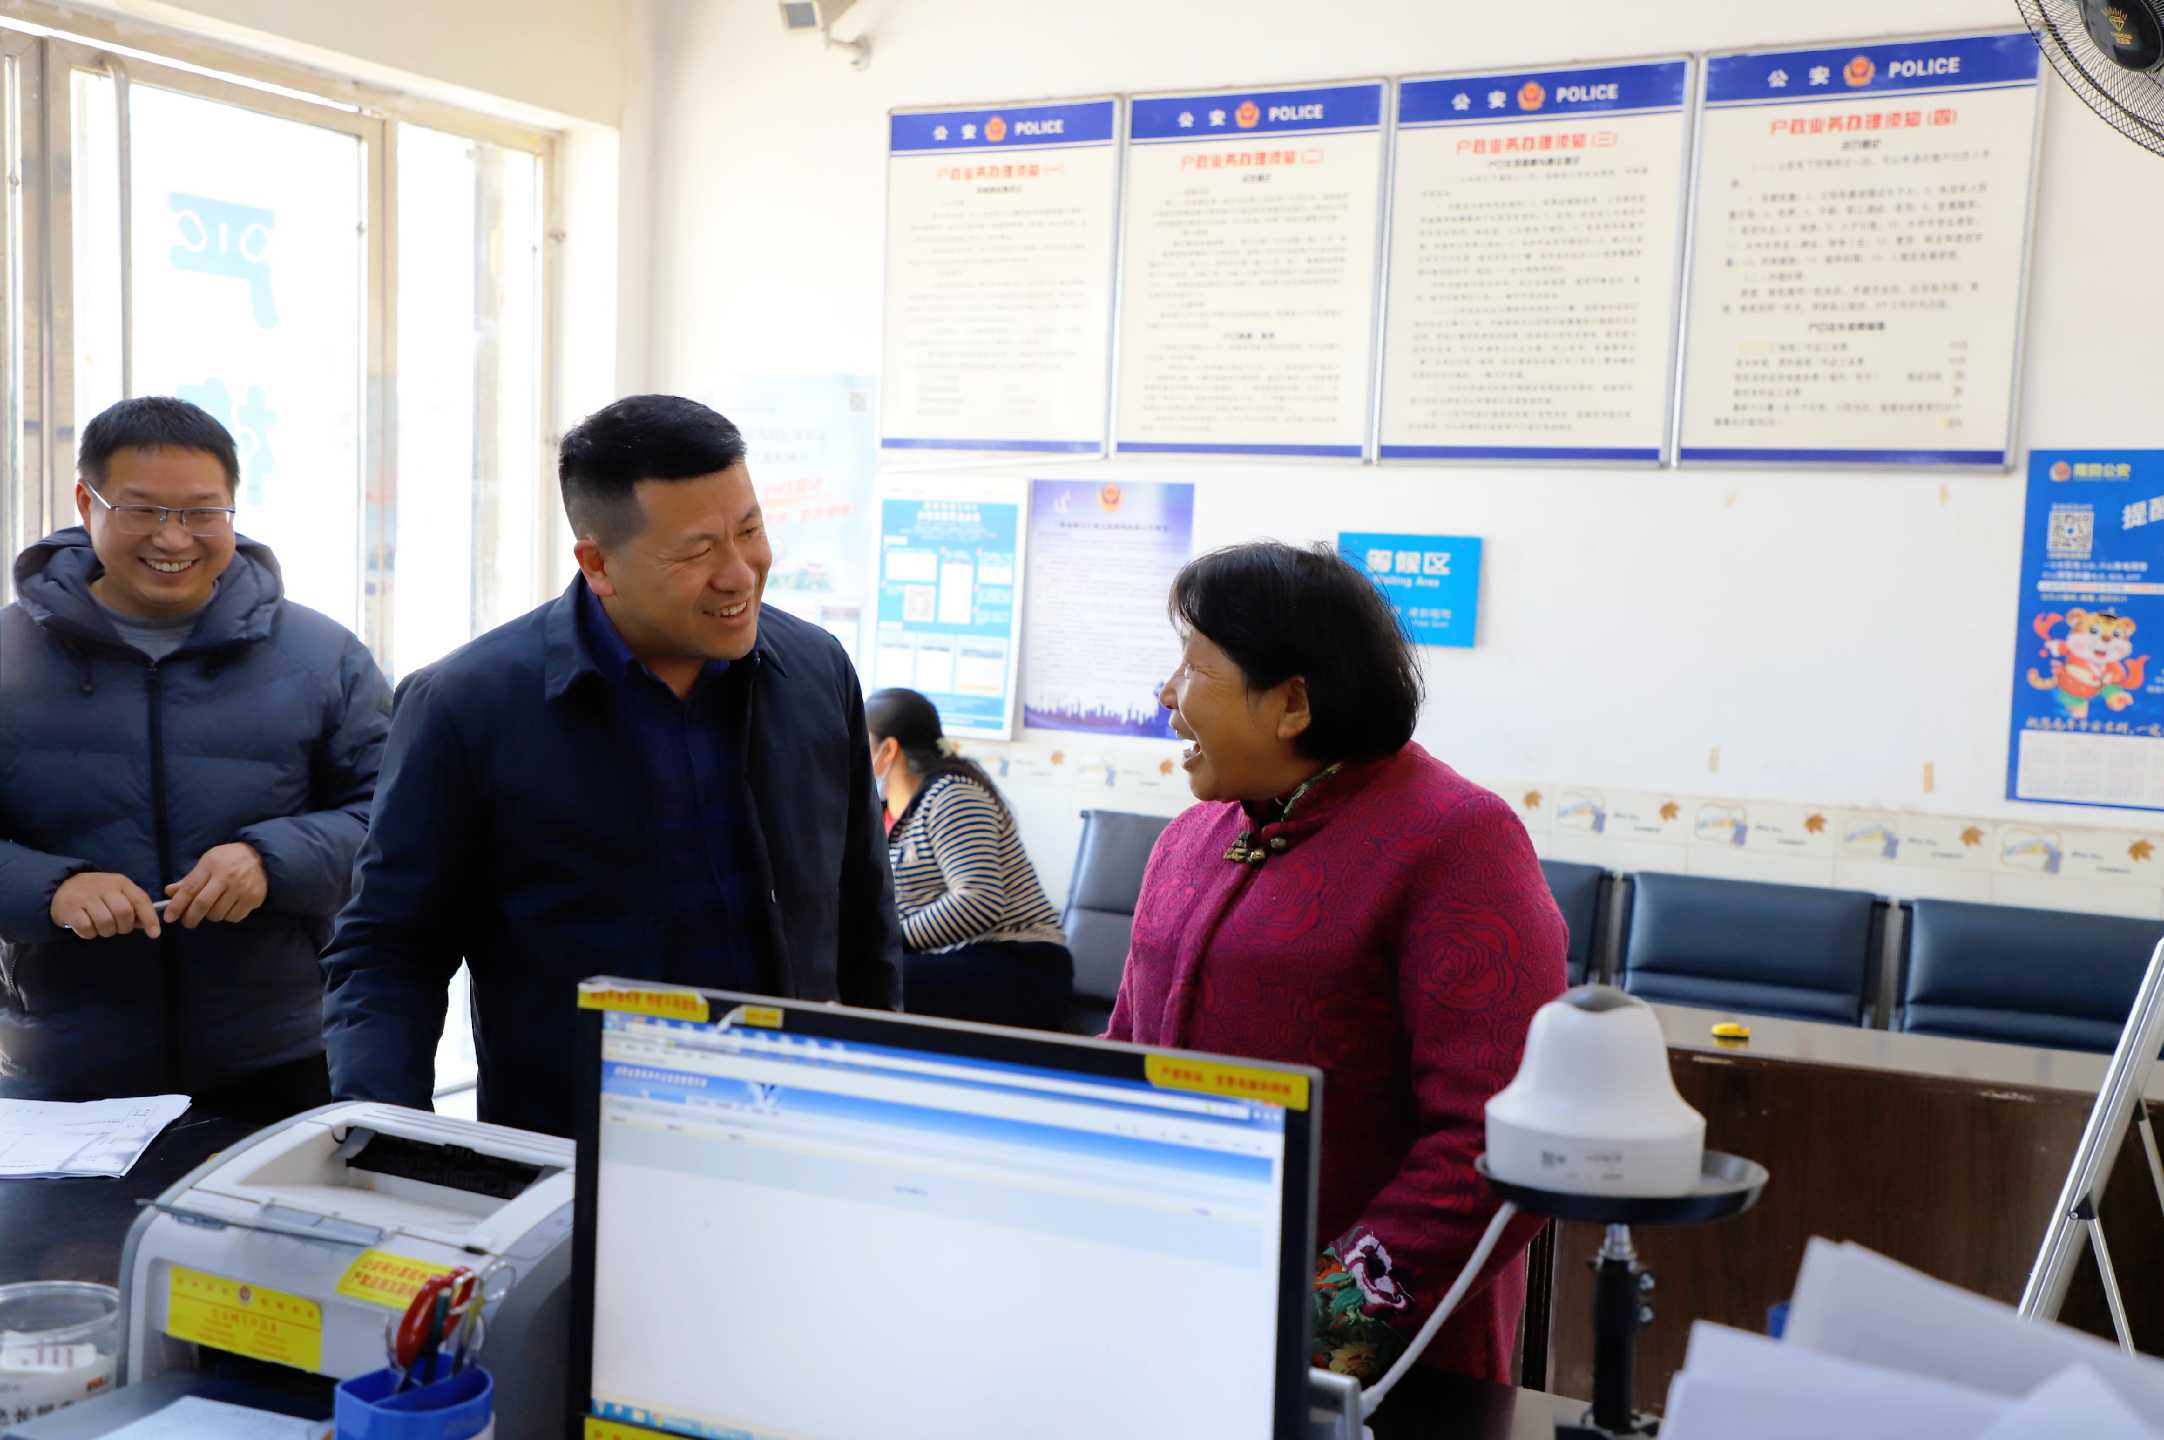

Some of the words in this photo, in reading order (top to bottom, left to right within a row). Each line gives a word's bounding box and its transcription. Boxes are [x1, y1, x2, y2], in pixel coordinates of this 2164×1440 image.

[1888, 56, 1960, 78] POLICE
[1556, 83, 1619, 103] POLICE
[1268, 104, 1324, 121] POLICE
[1015, 119, 1064, 136] POLICE
